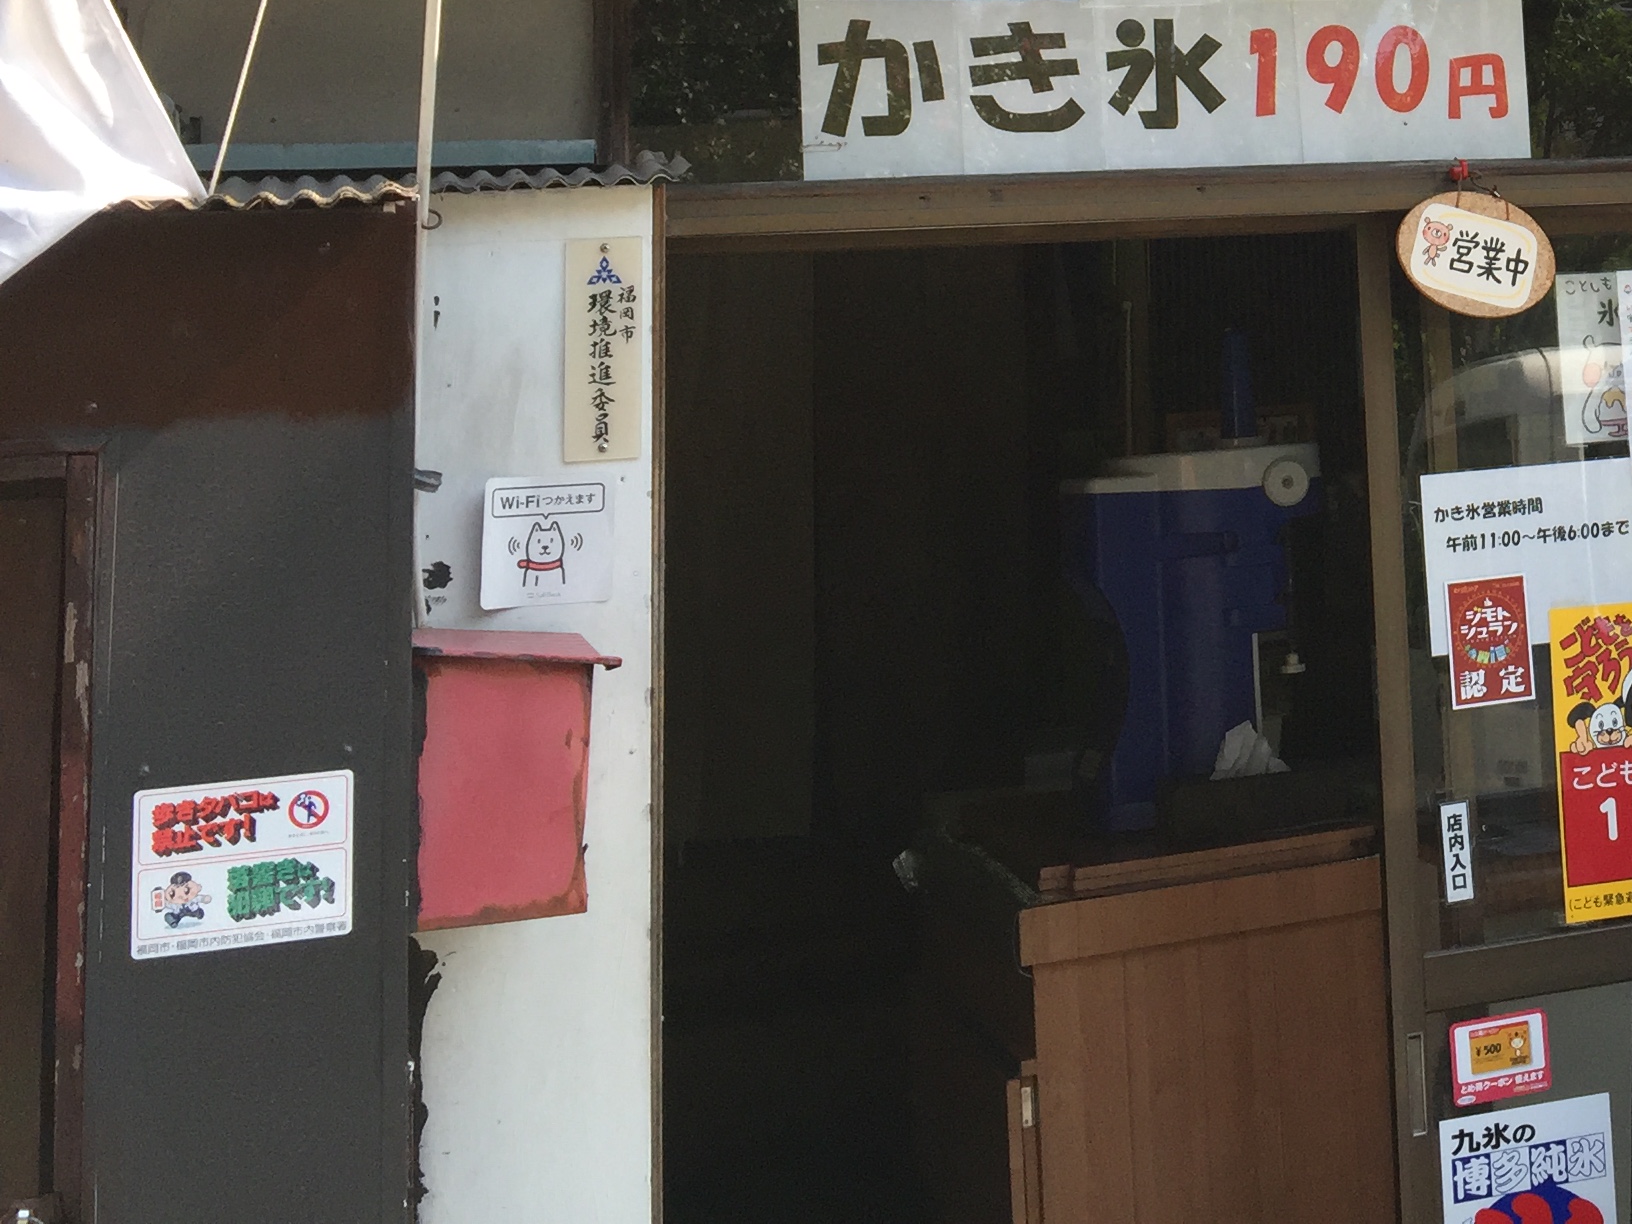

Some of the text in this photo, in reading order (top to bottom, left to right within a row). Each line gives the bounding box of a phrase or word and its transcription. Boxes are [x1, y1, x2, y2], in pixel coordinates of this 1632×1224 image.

[1447, 230, 1530, 287] 営業中
[1565, 276, 1612, 295] ことしも
[617, 286, 637, 344] 福岡市
[587, 289, 617, 443] 環境推進委員
[1434, 497, 1544, 523] かき氷営業時間
[1460, 620, 1518, 640] シュラン
[1465, 605, 1511, 625] ジモト
[1460, 664, 1525, 700] 認定
[1446, 813, 1468, 891] 店内入口
[1451, 1122, 1537, 1156] 九氷の
[1454, 1137, 1605, 1200] 博多純氷
